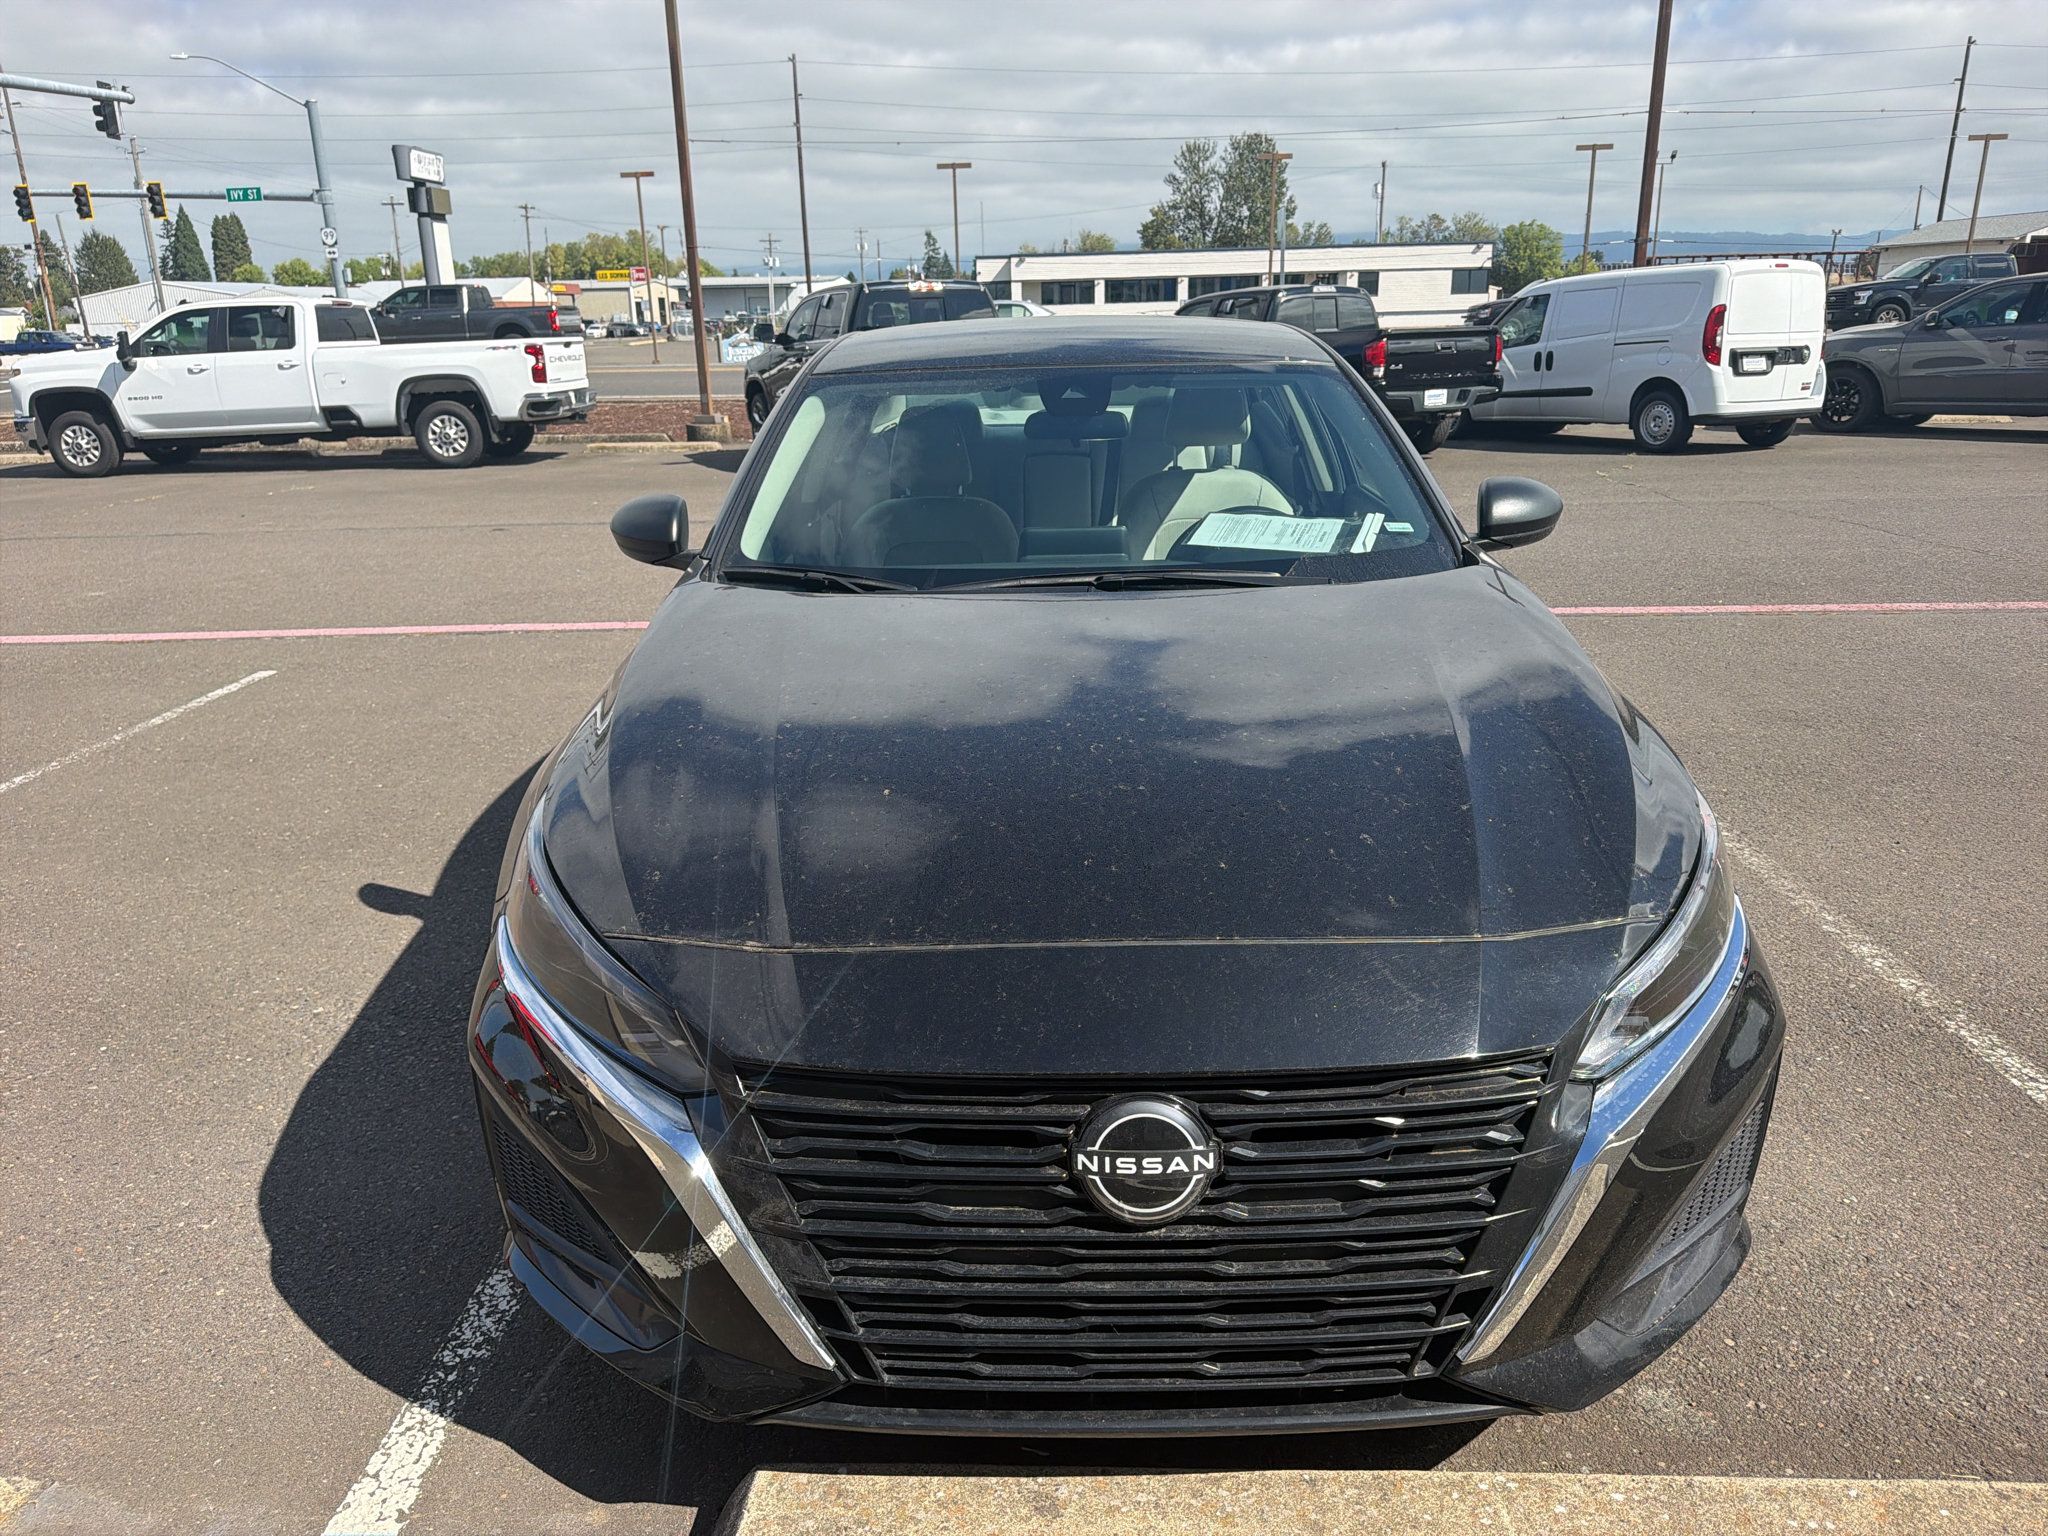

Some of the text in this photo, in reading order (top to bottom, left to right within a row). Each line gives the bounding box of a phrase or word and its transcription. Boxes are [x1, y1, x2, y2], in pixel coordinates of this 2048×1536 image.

[230, 188, 257, 201] IVY ST
[323, 230, 335, 241] 99
[1077, 1152, 1214, 1175] NISSAN
